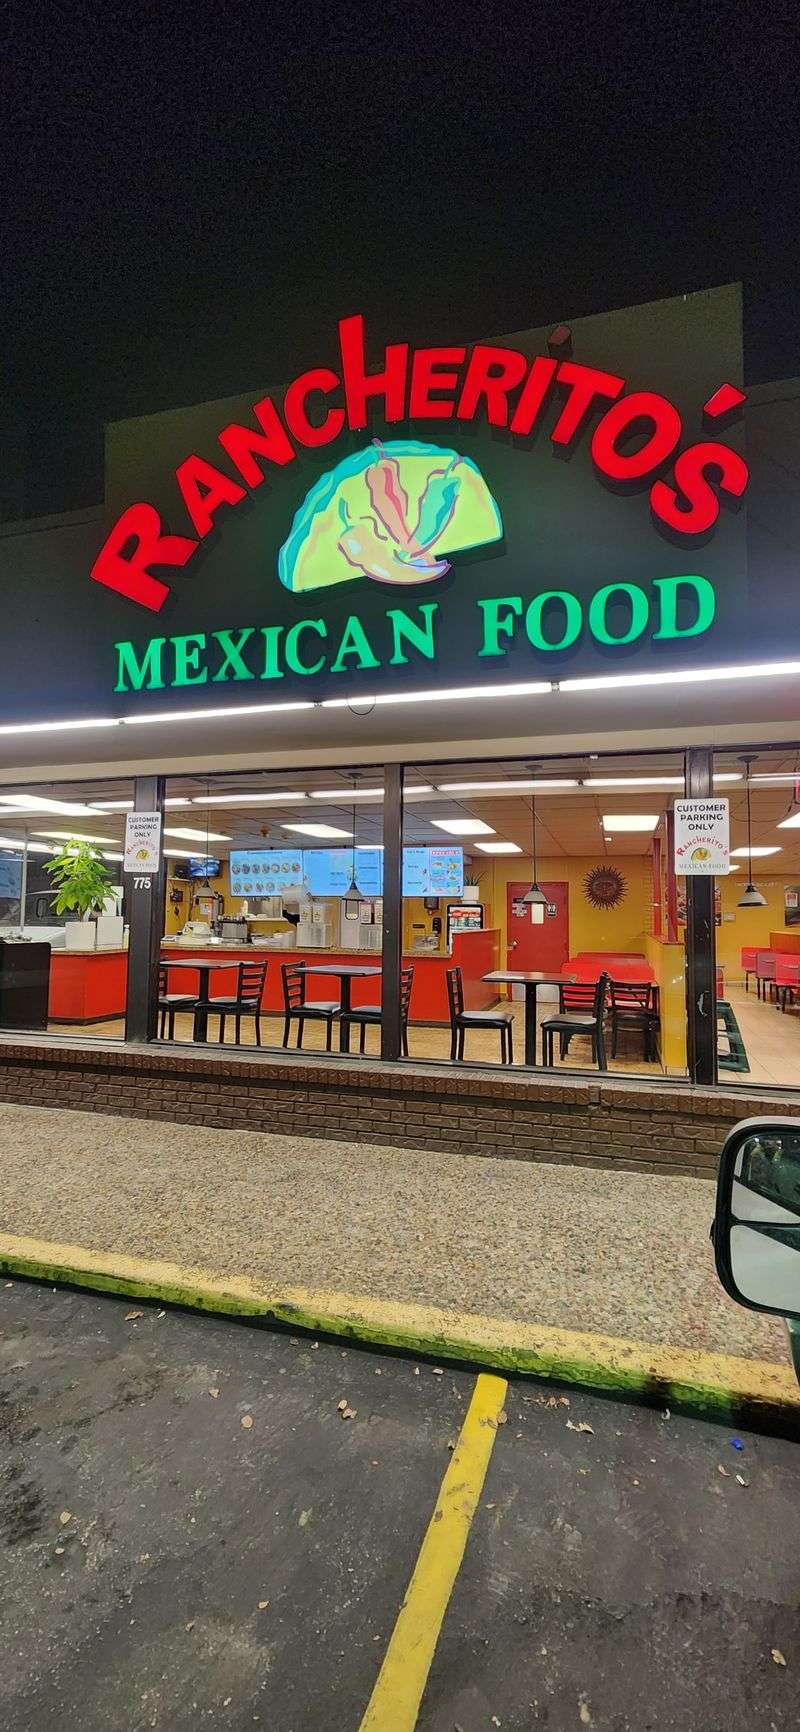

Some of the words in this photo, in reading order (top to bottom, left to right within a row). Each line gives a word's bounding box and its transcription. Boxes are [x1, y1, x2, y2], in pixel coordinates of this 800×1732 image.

[114, 603, 438, 692] MEXICAN
[477, 575, 717, 657] FOOD
[676, 804, 727, 813] CUSTOMER
[680, 813, 724, 821] PARKING
[687, 823, 715, 831] ONLY
[133, 877, 152, 889] 775
